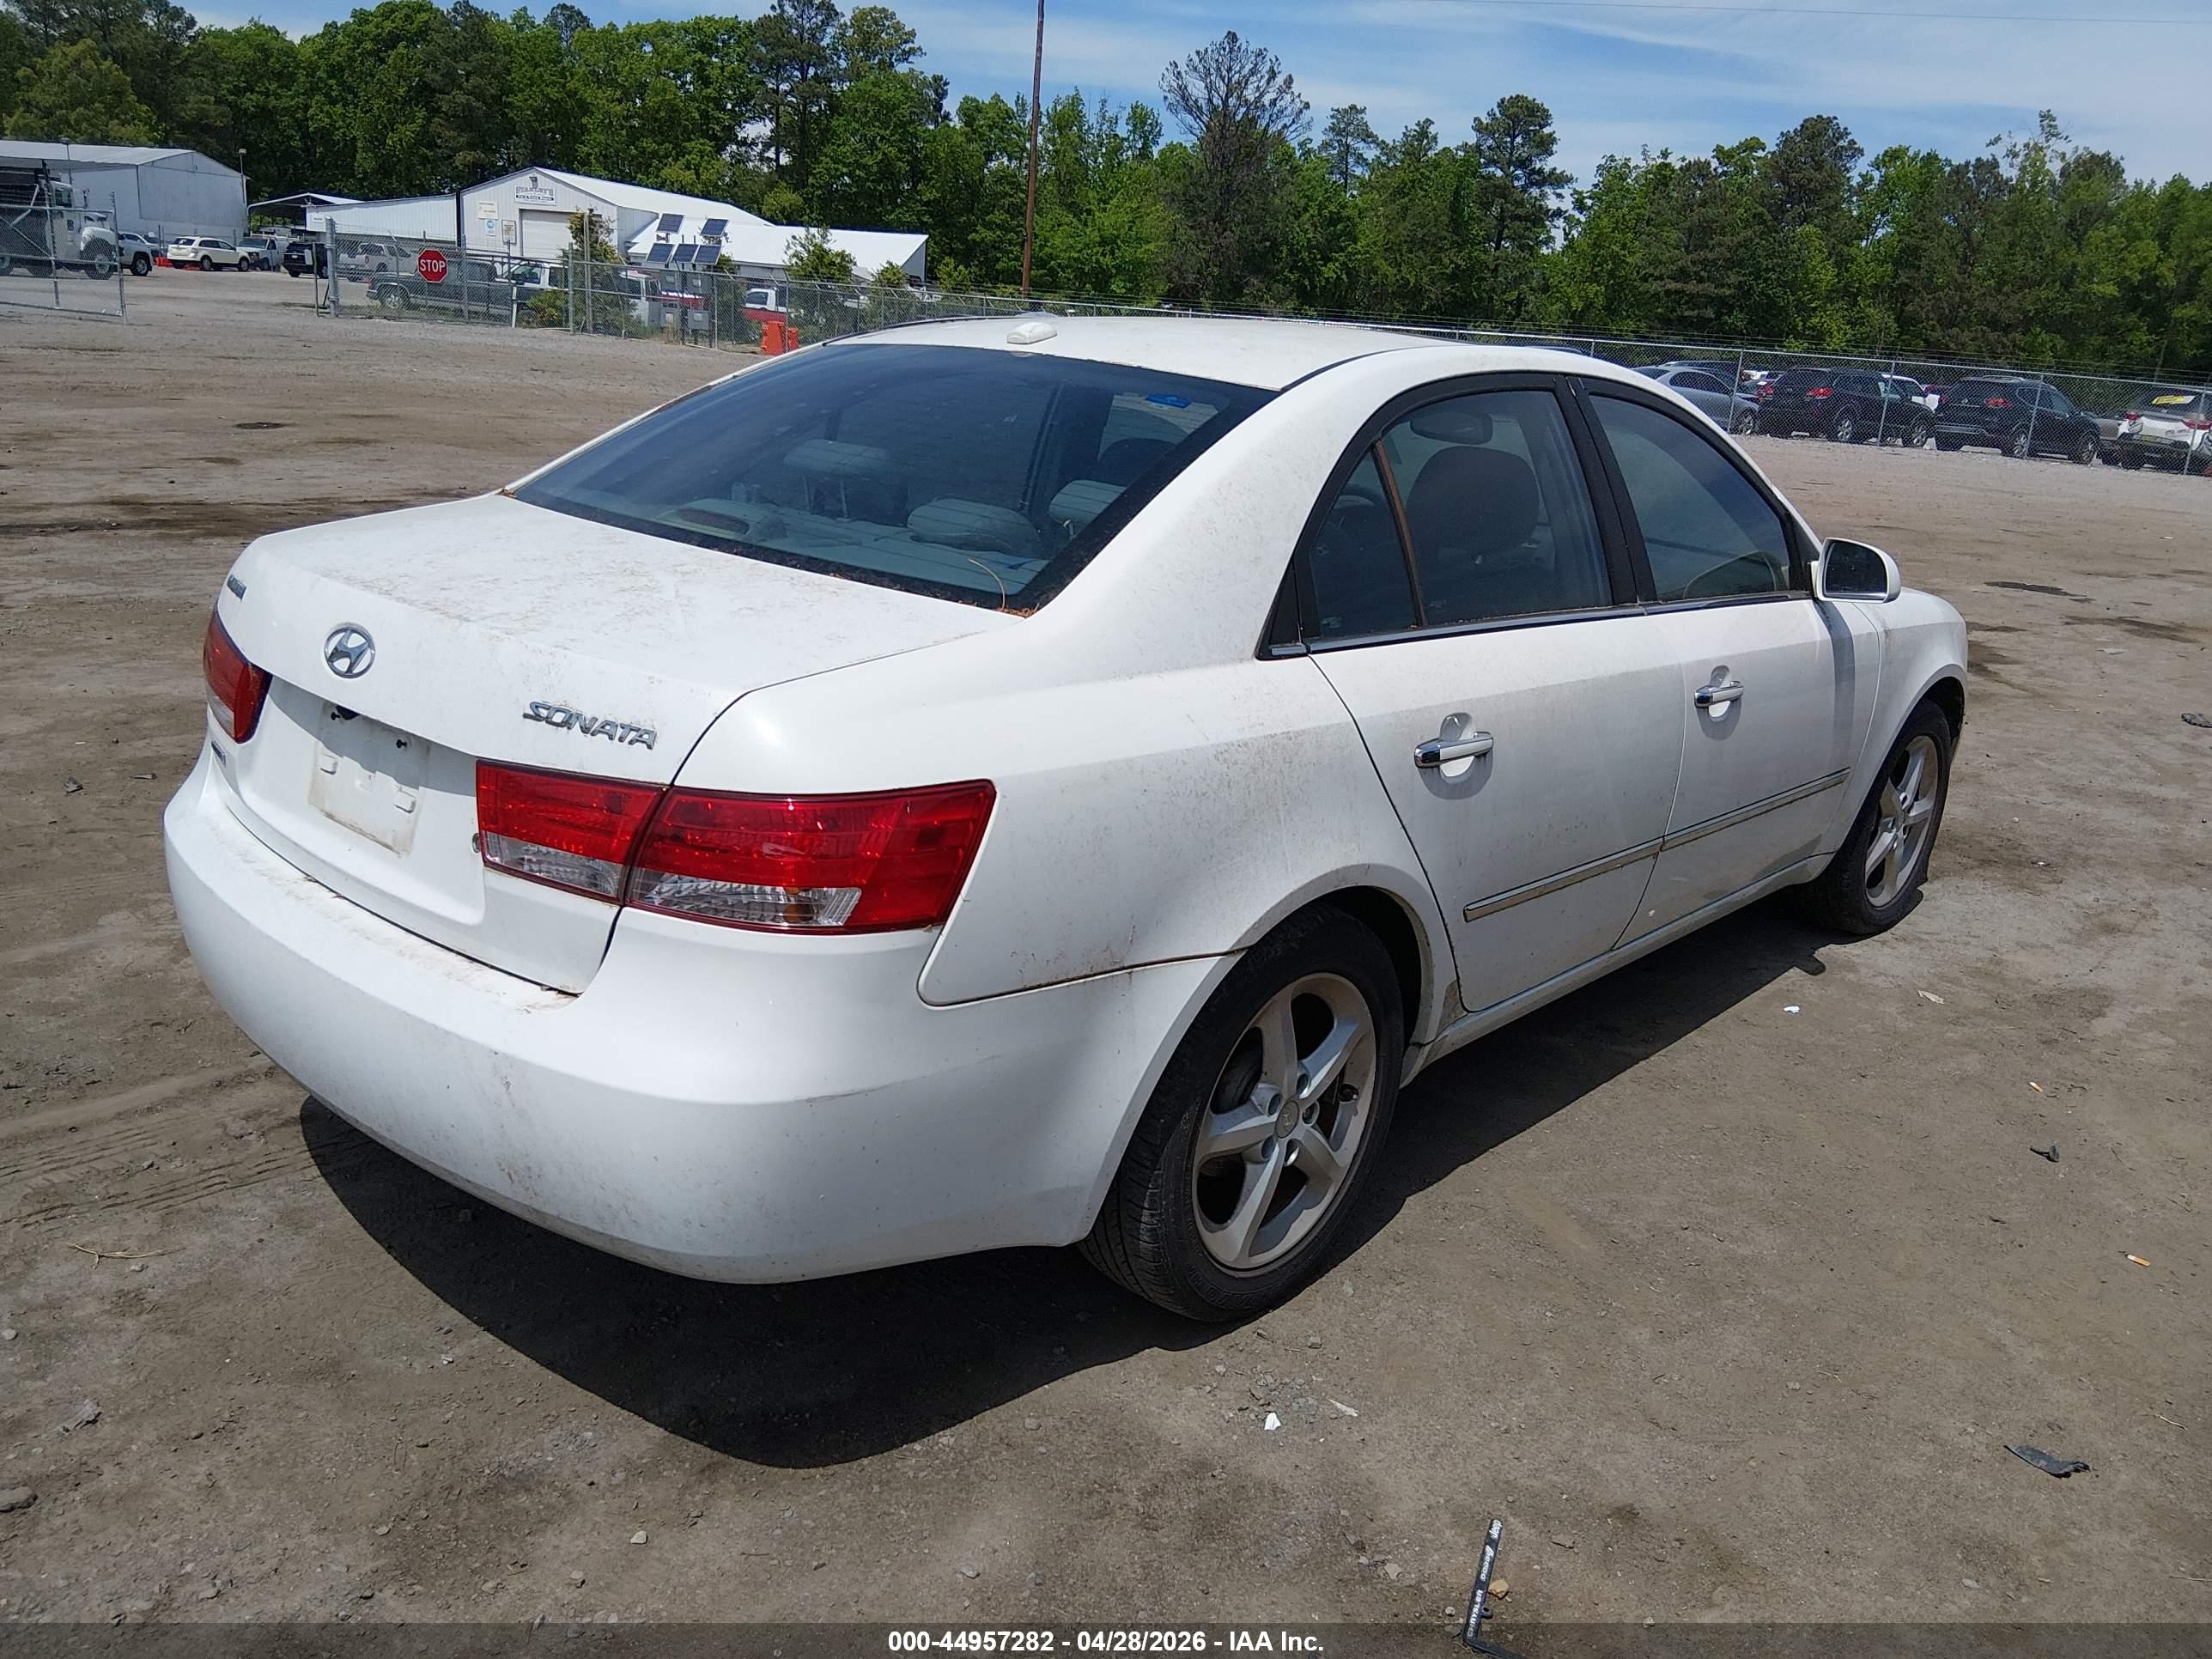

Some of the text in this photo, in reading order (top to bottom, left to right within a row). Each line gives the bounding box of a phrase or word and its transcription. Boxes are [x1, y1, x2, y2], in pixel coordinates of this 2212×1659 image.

[420, 258, 446, 273] STOP
[522, 701, 658, 750] SONATA
[1468, 1589, 1483, 1638] CHRYSLER
[1489, 1519, 1502, 1540] Jeep
